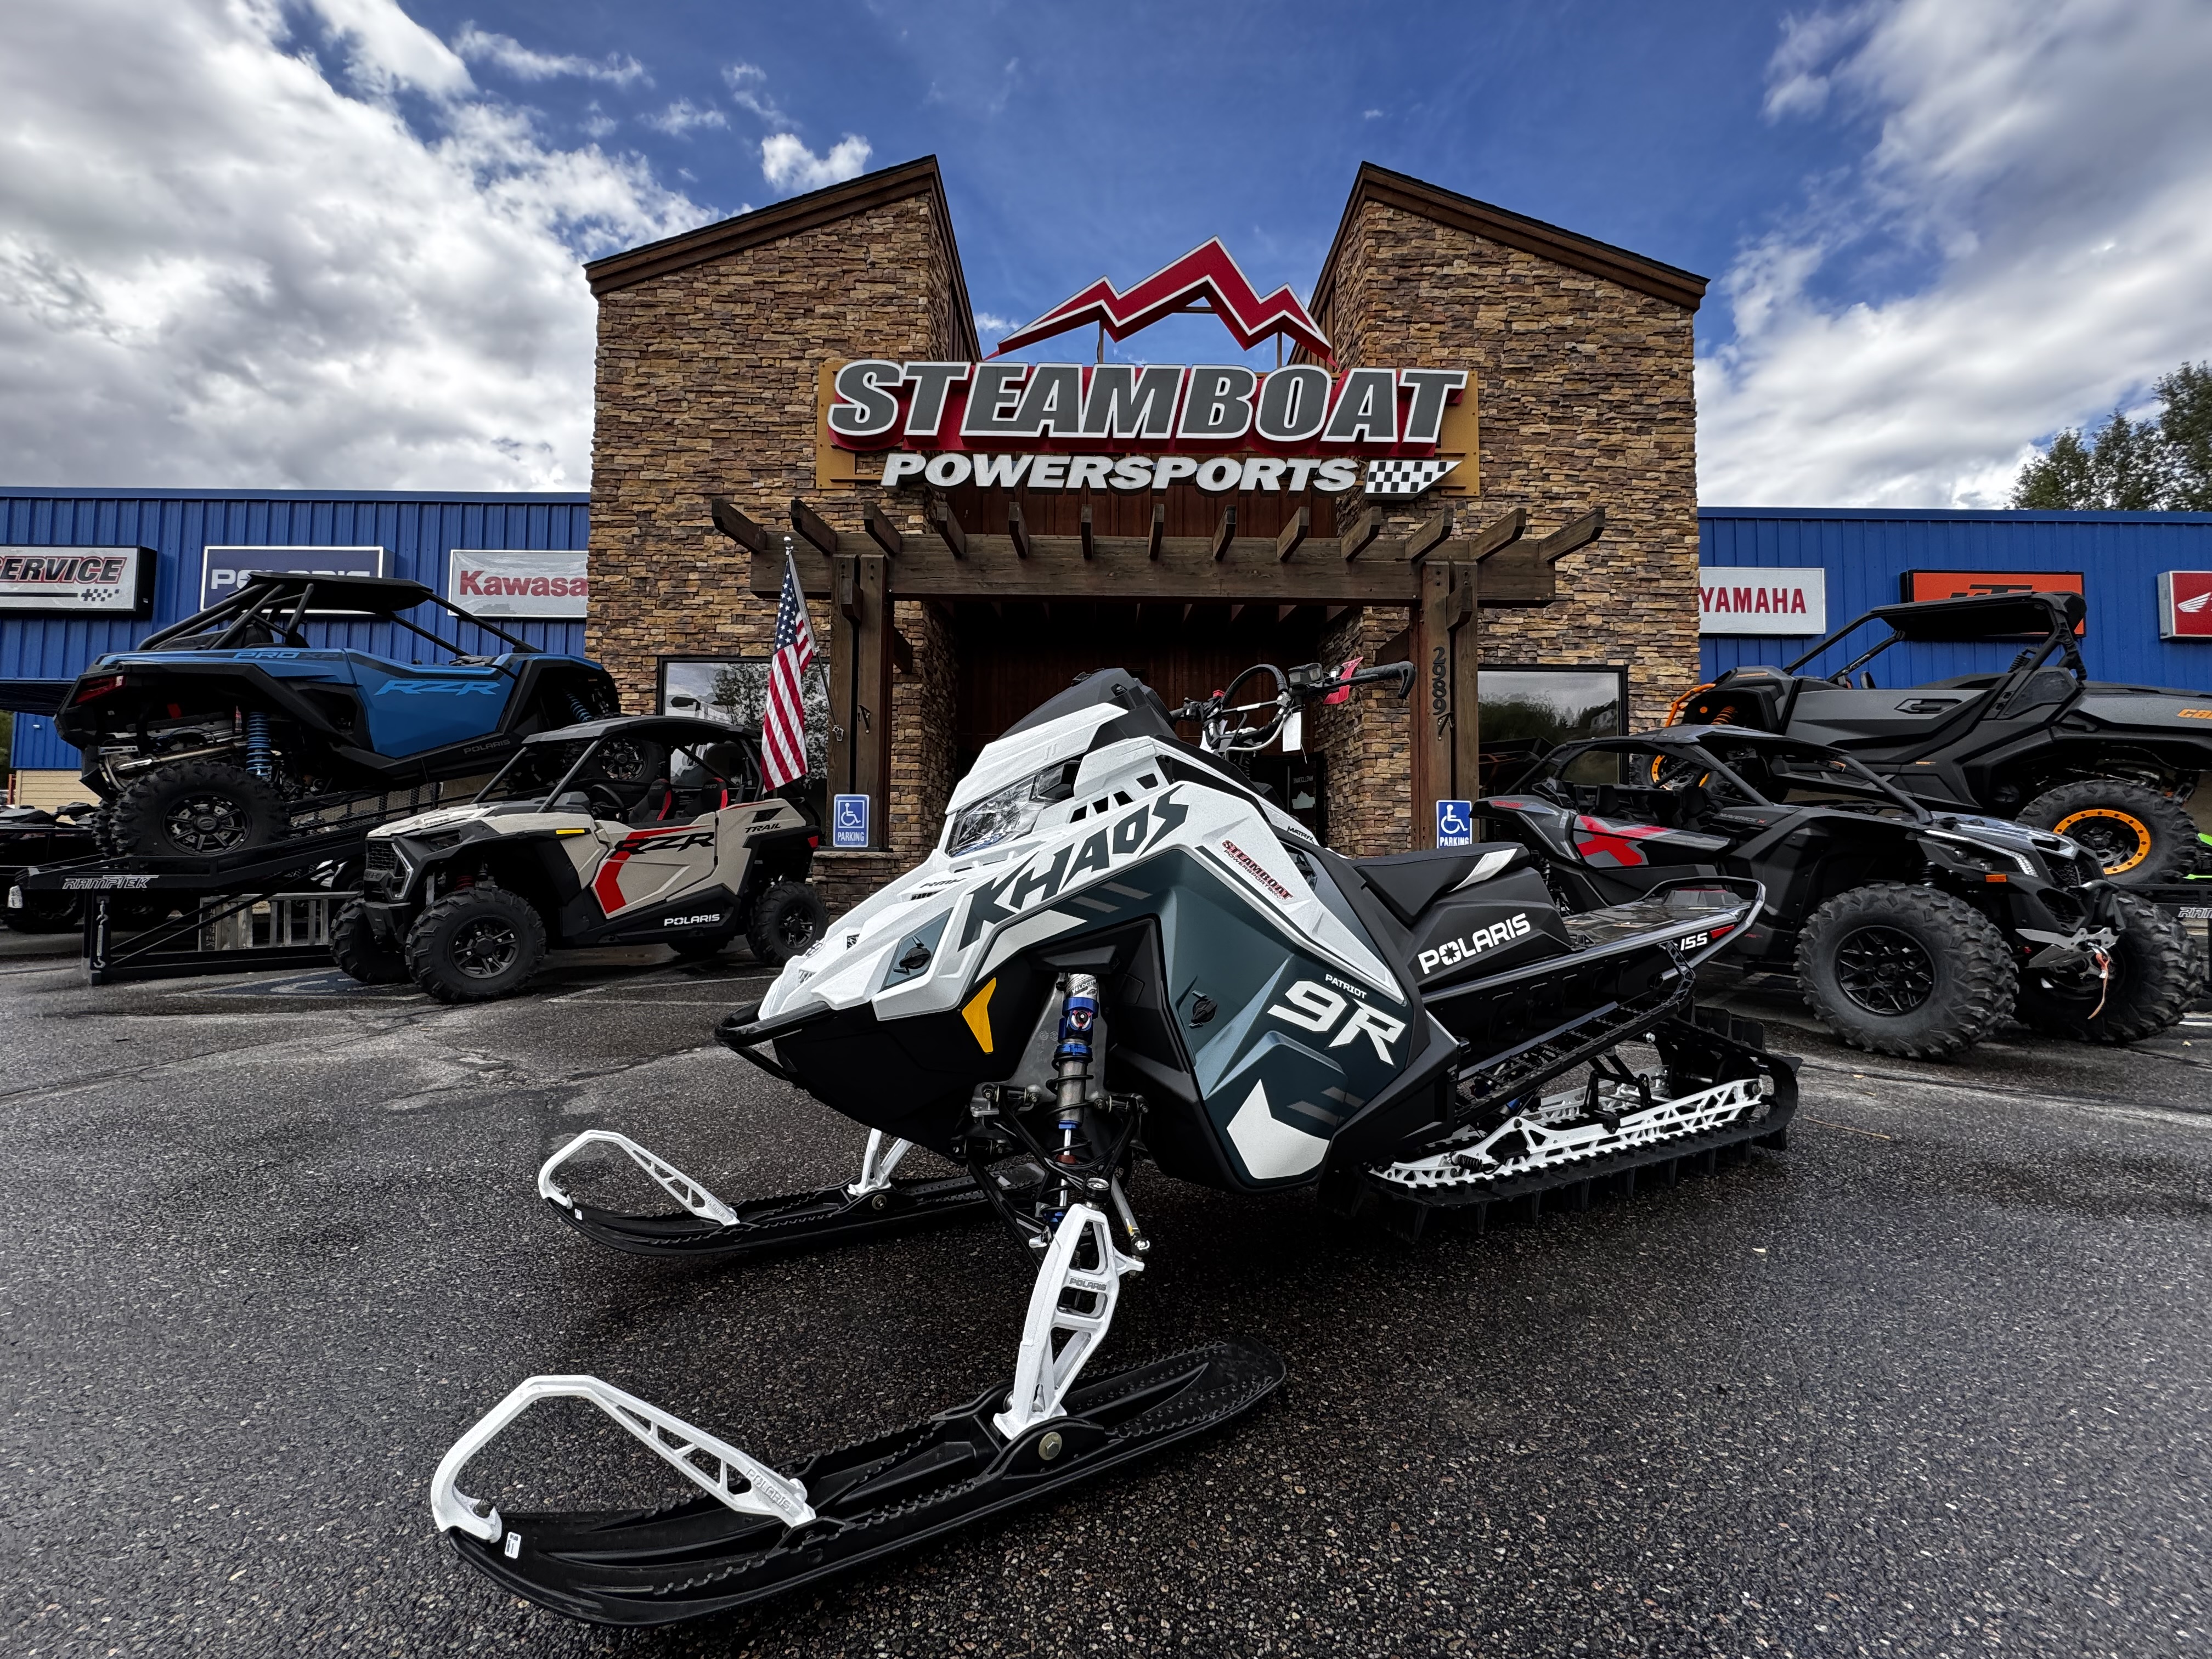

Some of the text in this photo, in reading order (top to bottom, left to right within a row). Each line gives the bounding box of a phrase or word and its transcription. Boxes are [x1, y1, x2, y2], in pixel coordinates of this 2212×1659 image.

[827, 359, 1469, 443] STEAMBOAT
[881, 453, 1359, 492] POWERSPORTS
[0, 556, 128, 584] ERVICE
[1699, 586, 1807, 614] YAMAHA
[374, 680, 501, 696] RZR
[1432, 646, 1447, 715] 2989
[464, 739, 511, 754] POLARIS
[745, 823, 781, 833] TRAIL
[837, 832, 865, 842] PARKING
[1286, 826, 1314, 844] MATRYX
[1440, 837, 1469, 847] PARKING
[608, 832, 715, 860] RZR
[957, 784, 1189, 952] KHAOS
[1221, 839, 1294, 900] STEAMBOAT
[1223, 849, 1275, 893] POWERSPORTS
[664, 913, 720, 927] POLARIS
[1418, 913, 1531, 974] POLARIS
[1680, 932, 1708, 951] 155
[1325, 973, 1367, 999] PATRIOT
[1267, 980, 1407, 1066] 9R
[1069, 1278, 1107, 1291] POLARIS
[746, 1468, 791, 1510] POLARIS
